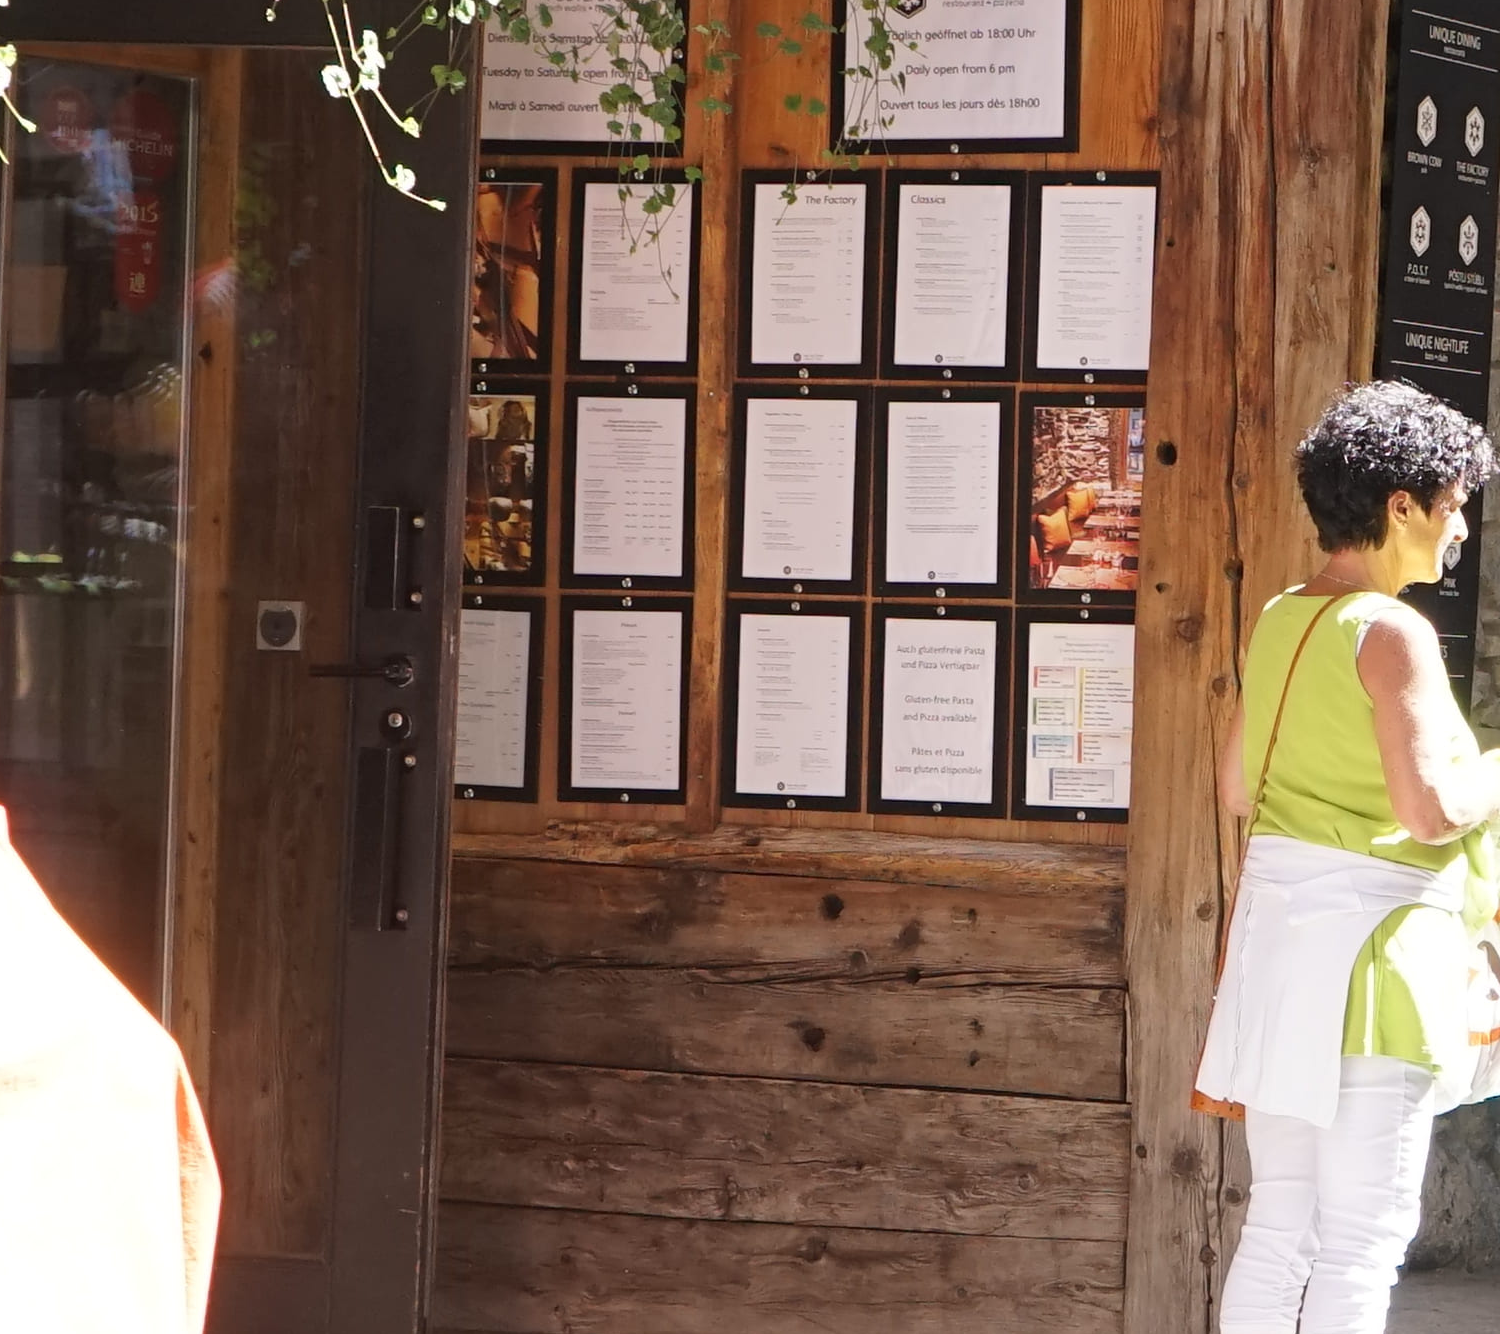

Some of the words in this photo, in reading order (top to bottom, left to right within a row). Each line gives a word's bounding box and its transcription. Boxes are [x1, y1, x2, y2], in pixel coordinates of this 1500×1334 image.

[549, 33, 593, 46] Samstag
[925, 28, 968, 42] geöffnet
[970, 29, 984, 39] ab
[987, 28, 1015, 39] 18:00
[1017, 28, 1036, 39] Uhr
[1429, 24, 1455, 45] UNIQUE
[1457, 31, 1482, 51] DINING
[483, 67, 521, 79] Tuesday
[524, 68, 534, 78] to
[583, 69, 608, 82] open
[905, 65, 930, 76] Daily
[933, 66, 959, 76] open
[962, 64, 987, 74] from
[989, 64, 996, 74] 6
[998, 65, 1015, 75] pm
[488, 101, 517, 111] Mardi
[520, 100, 526, 111] à
[529, 101, 565, 112] Samedi
[567, 102, 599, 112] ouvert
[880, 99, 915, 110] Ouvert
[917, 100, 939, 110] tous
[942, 99, 957, 109] les
[959, 99, 985, 110] jours
[988, 98, 1005, 109] dès
[1009, 98, 1040, 109] 18h00
[804, 195, 822, 205] The
[824, 195, 857, 206] Factory
[910, 194, 946, 205] Classics
[1405, 331, 1433, 350] UNIQUE
[1434, 336, 1469, 355] NIGHTLIFE
[964, 645, 986, 655] Pasta
[918, 661, 938, 669] Pizza
[904, 694, 950, 705] Gluten-free
[952, 695, 974, 705] Pasta
[903, 713, 918, 721] and
[920, 713, 940, 722] Pizza
[941, 713, 978, 723] available
[935, 748, 943, 756] et
[945, 747, 965, 757] Pizza
[913, 765, 939, 775] gluten
[941, 766, 983, 776] disponible
